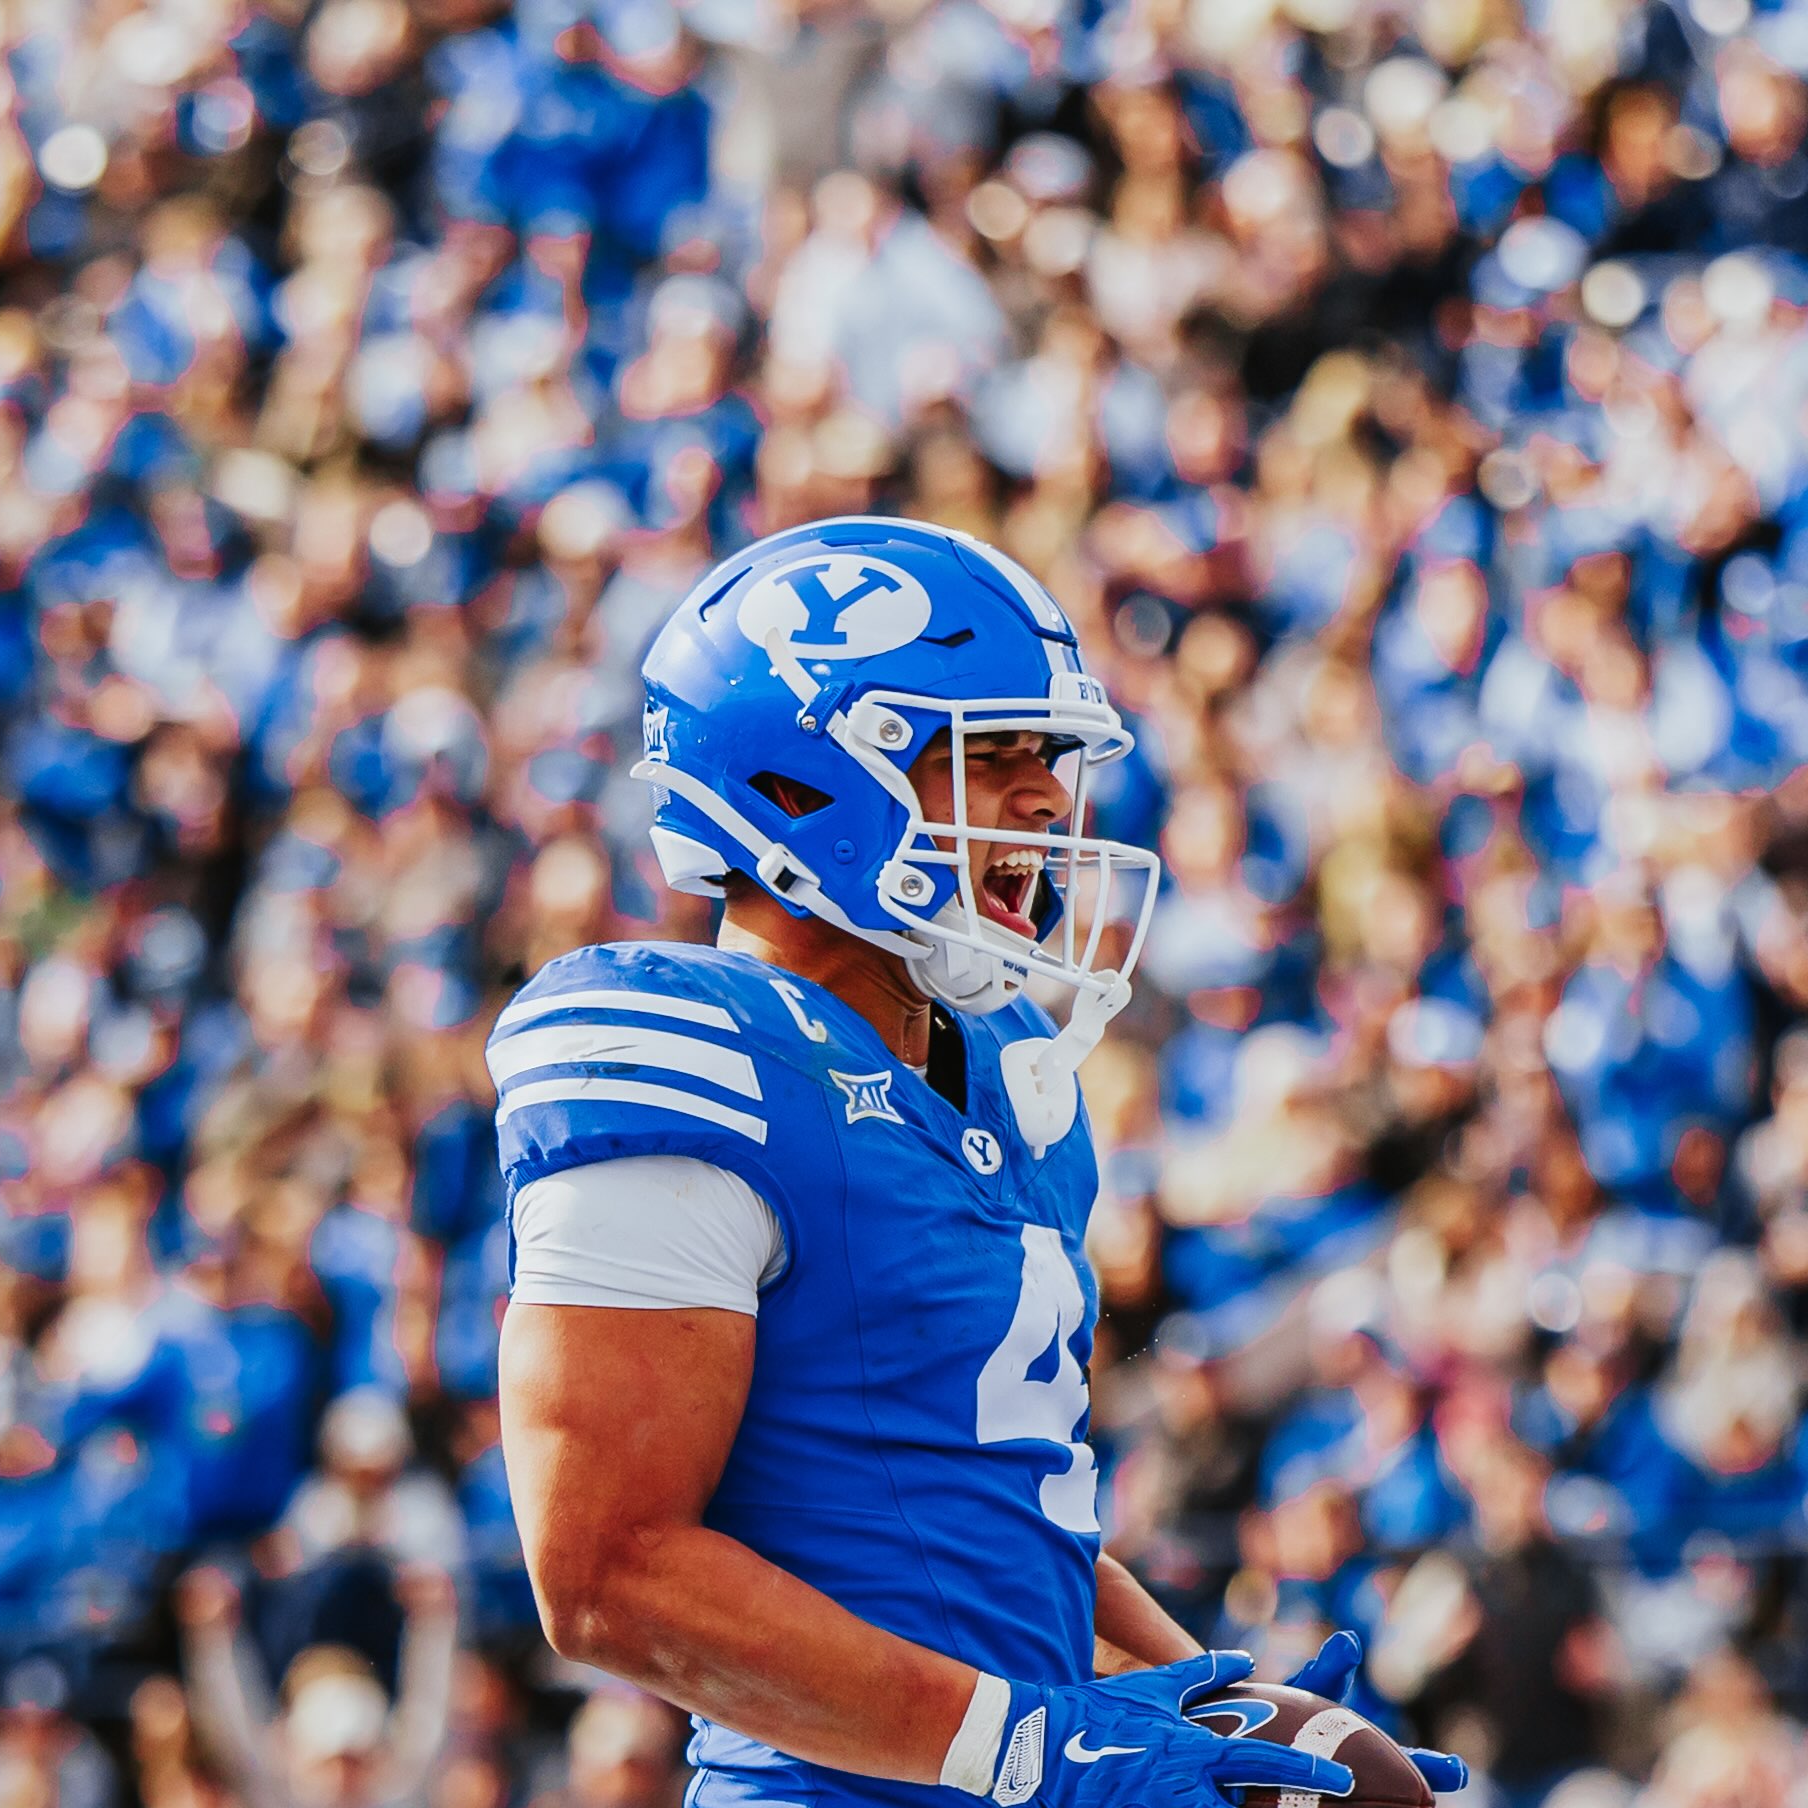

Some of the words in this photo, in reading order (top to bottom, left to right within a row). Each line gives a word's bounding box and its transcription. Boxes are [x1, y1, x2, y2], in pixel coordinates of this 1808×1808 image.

[773, 562, 903, 645] Y
[769, 980, 829, 1044] C
[968, 1135, 993, 1167] Y
[976, 1223, 1101, 1533] 4
